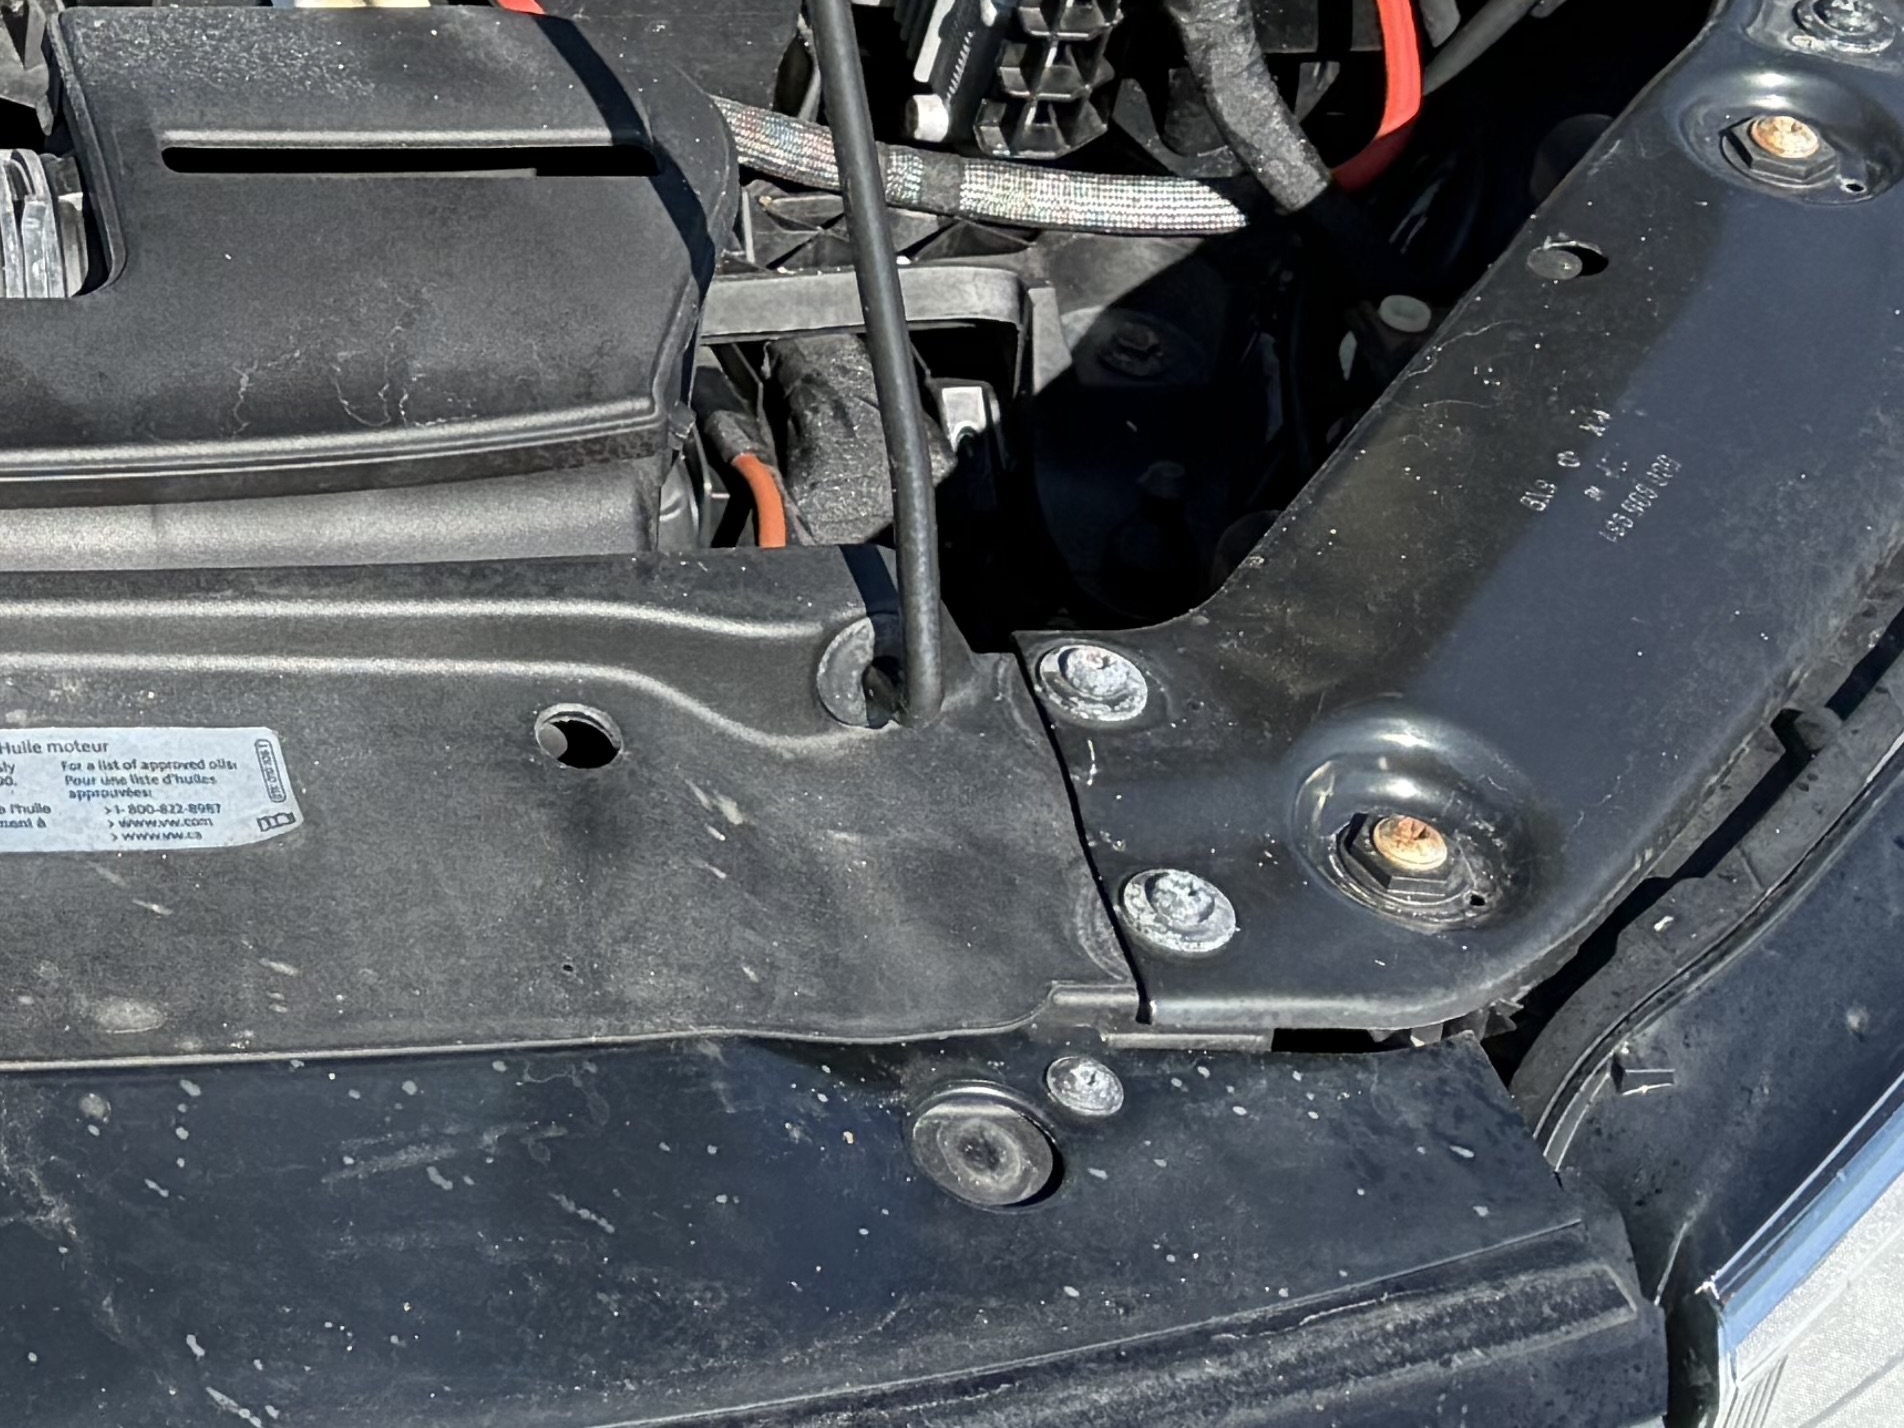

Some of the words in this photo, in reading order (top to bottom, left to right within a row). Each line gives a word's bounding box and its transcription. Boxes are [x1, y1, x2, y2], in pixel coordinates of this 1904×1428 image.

[47, 740, 108, 753] moteur
[61, 761, 82, 771] For
[97, 760, 118, 771] list
[122, 759, 137, 770] of
[140, 759, 205, 772] approved
[65, 775, 96, 786] Pour
[100, 776, 127, 786] une
[130, 774, 159, 785] liste
[162, 773, 217, 785] d'huiles
[10, 802, 51, 814] l'huile
